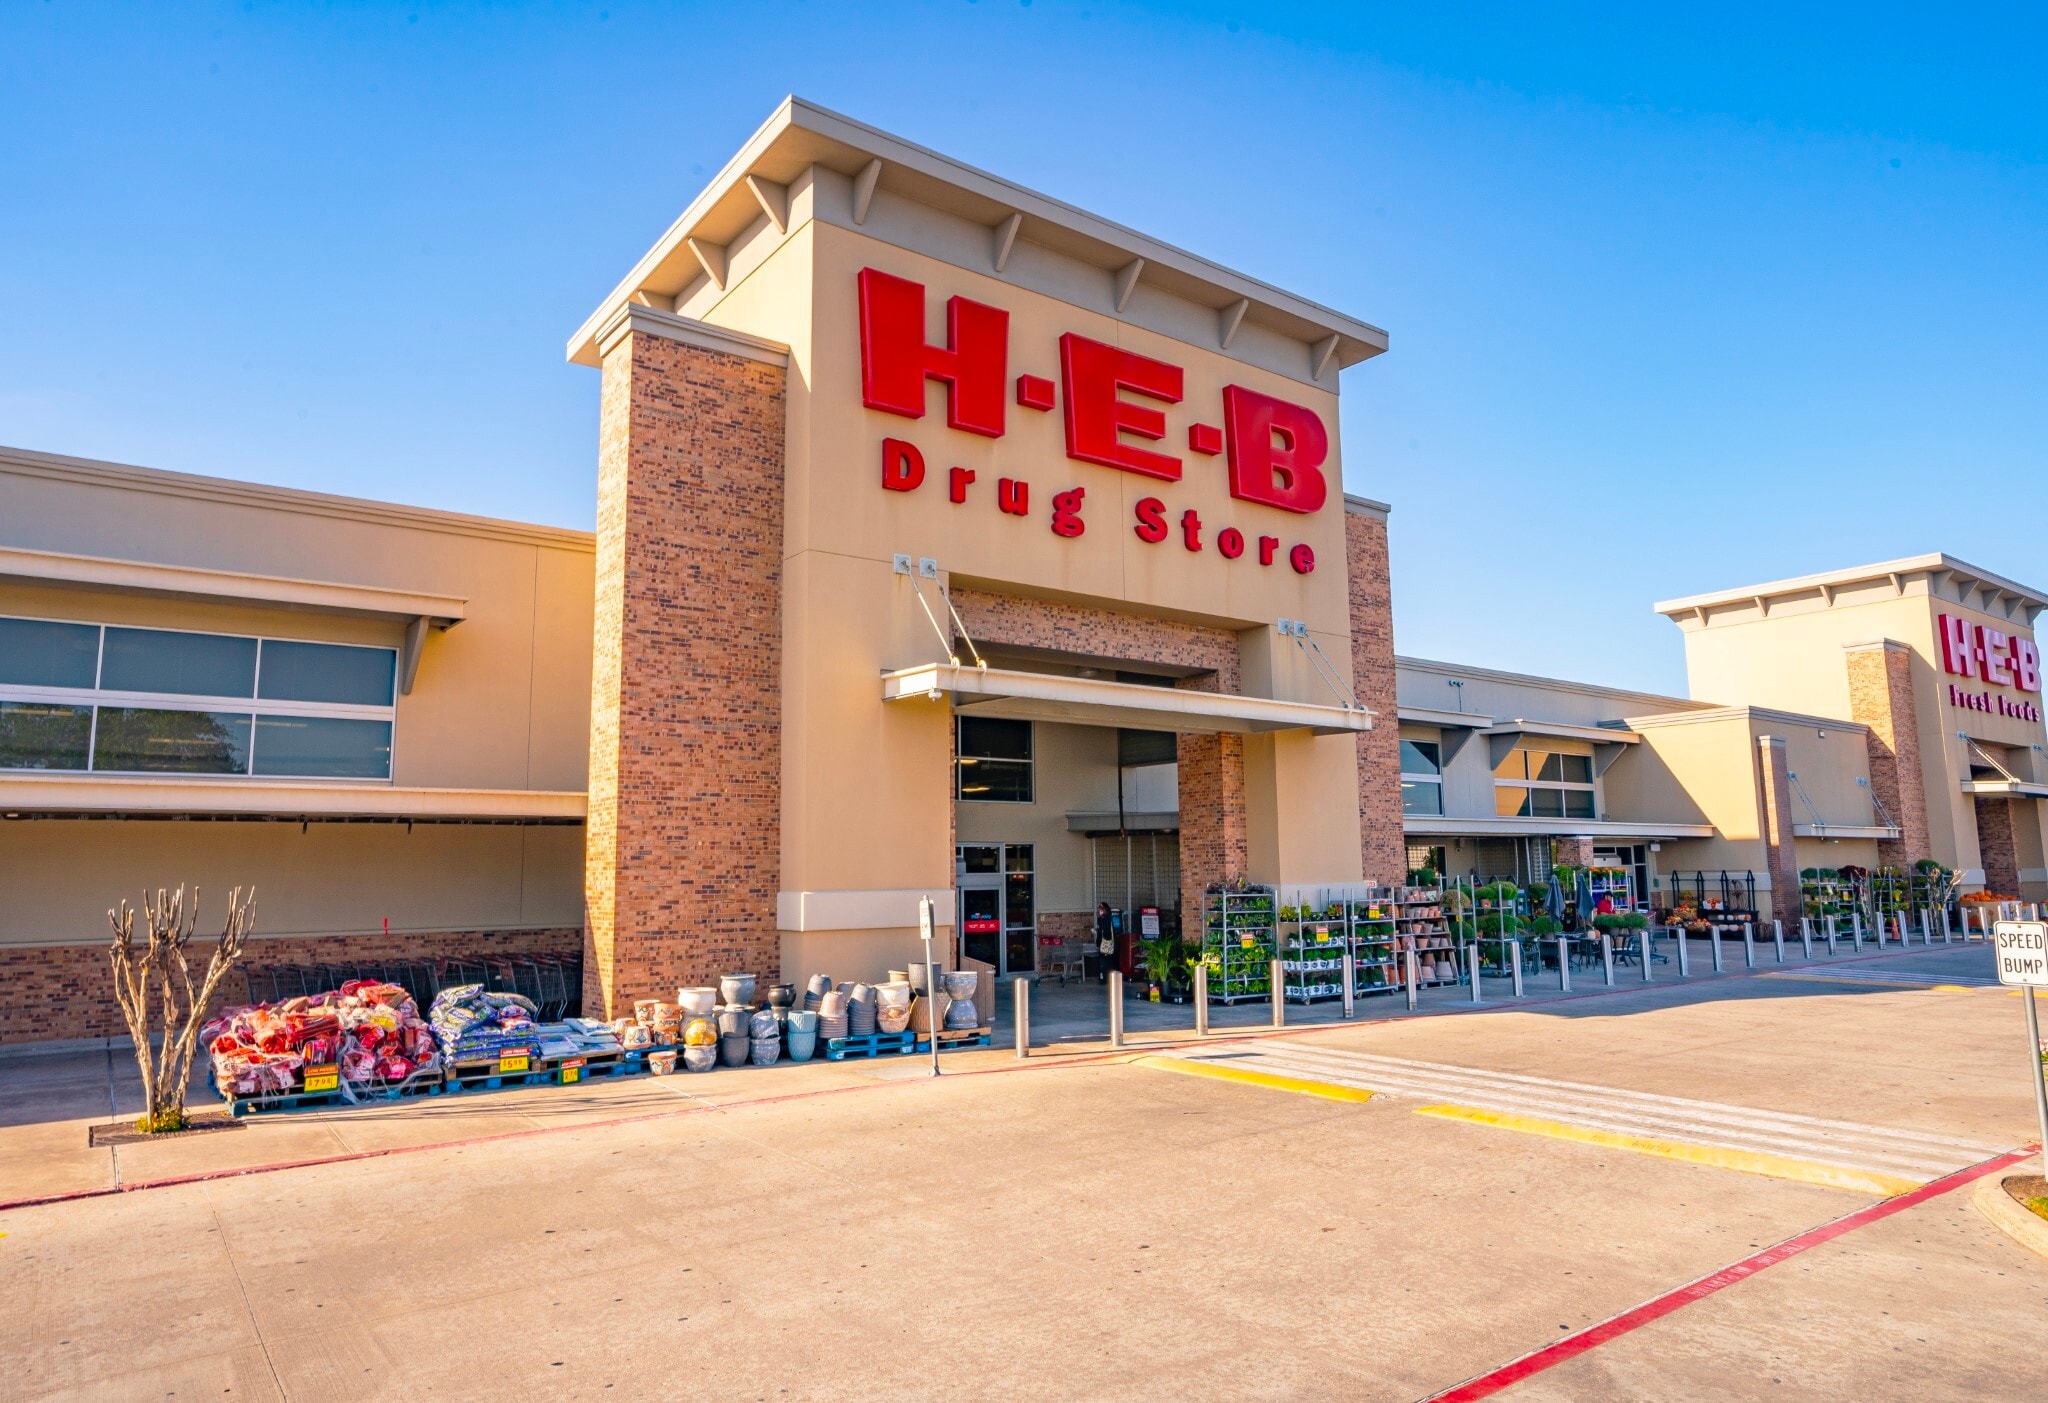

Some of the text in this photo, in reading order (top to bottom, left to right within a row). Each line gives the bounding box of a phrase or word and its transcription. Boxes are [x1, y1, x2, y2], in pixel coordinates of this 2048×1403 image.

[858, 267, 1328, 514] H-E-B
[882, 437, 1316, 574] Drug Store
[1938, 614, 2042, 692] H-E-B
[1949, 684, 2040, 722] Fresh Foods
[2000, 933, 2043, 949] SPEED
[2004, 958, 2043, 974] BUMP
